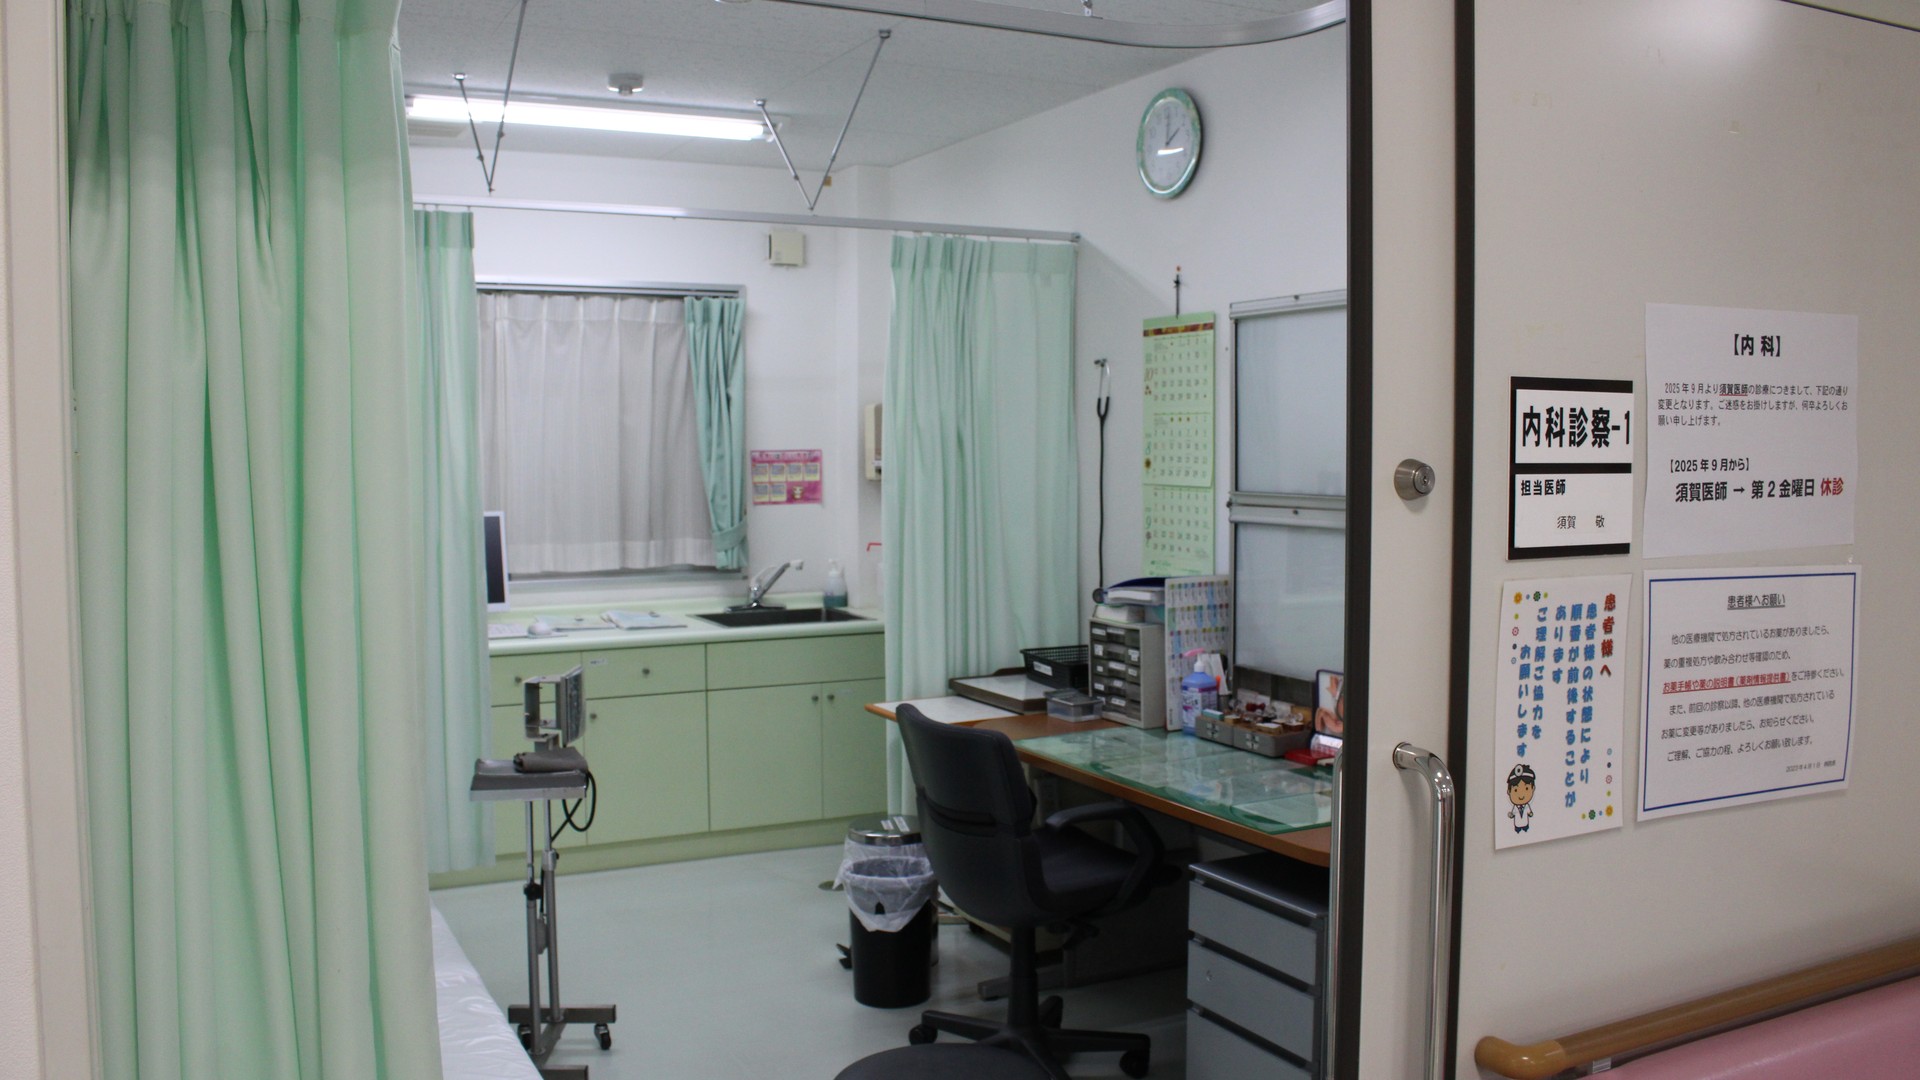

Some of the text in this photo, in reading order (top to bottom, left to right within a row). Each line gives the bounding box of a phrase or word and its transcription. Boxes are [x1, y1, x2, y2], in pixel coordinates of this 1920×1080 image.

[1522, 405, 1630, 448] 内科診察-1
[1657, 414, 1721, 427] 願い申し上げます。
[1520, 479, 1566, 496] 担当医師
[1675, 481, 1728, 502] 須賀医師
[1820, 477, 1844, 496] 休診
[1557, 515, 1576, 529] 須賀
[1727, 593, 1786, 608] 患者様へお願い
[1552, 604, 1567, 684] あります
[1600, 593, 1615, 678] 患者様へ
[1516, 644, 1531, 758] お願いします
[1532, 606, 1548, 740] ご理解ご協力を
[1580, 602, 1598, 784] 患者様の状態により
[1564, 603, 1583, 808] 順番が前後することが
